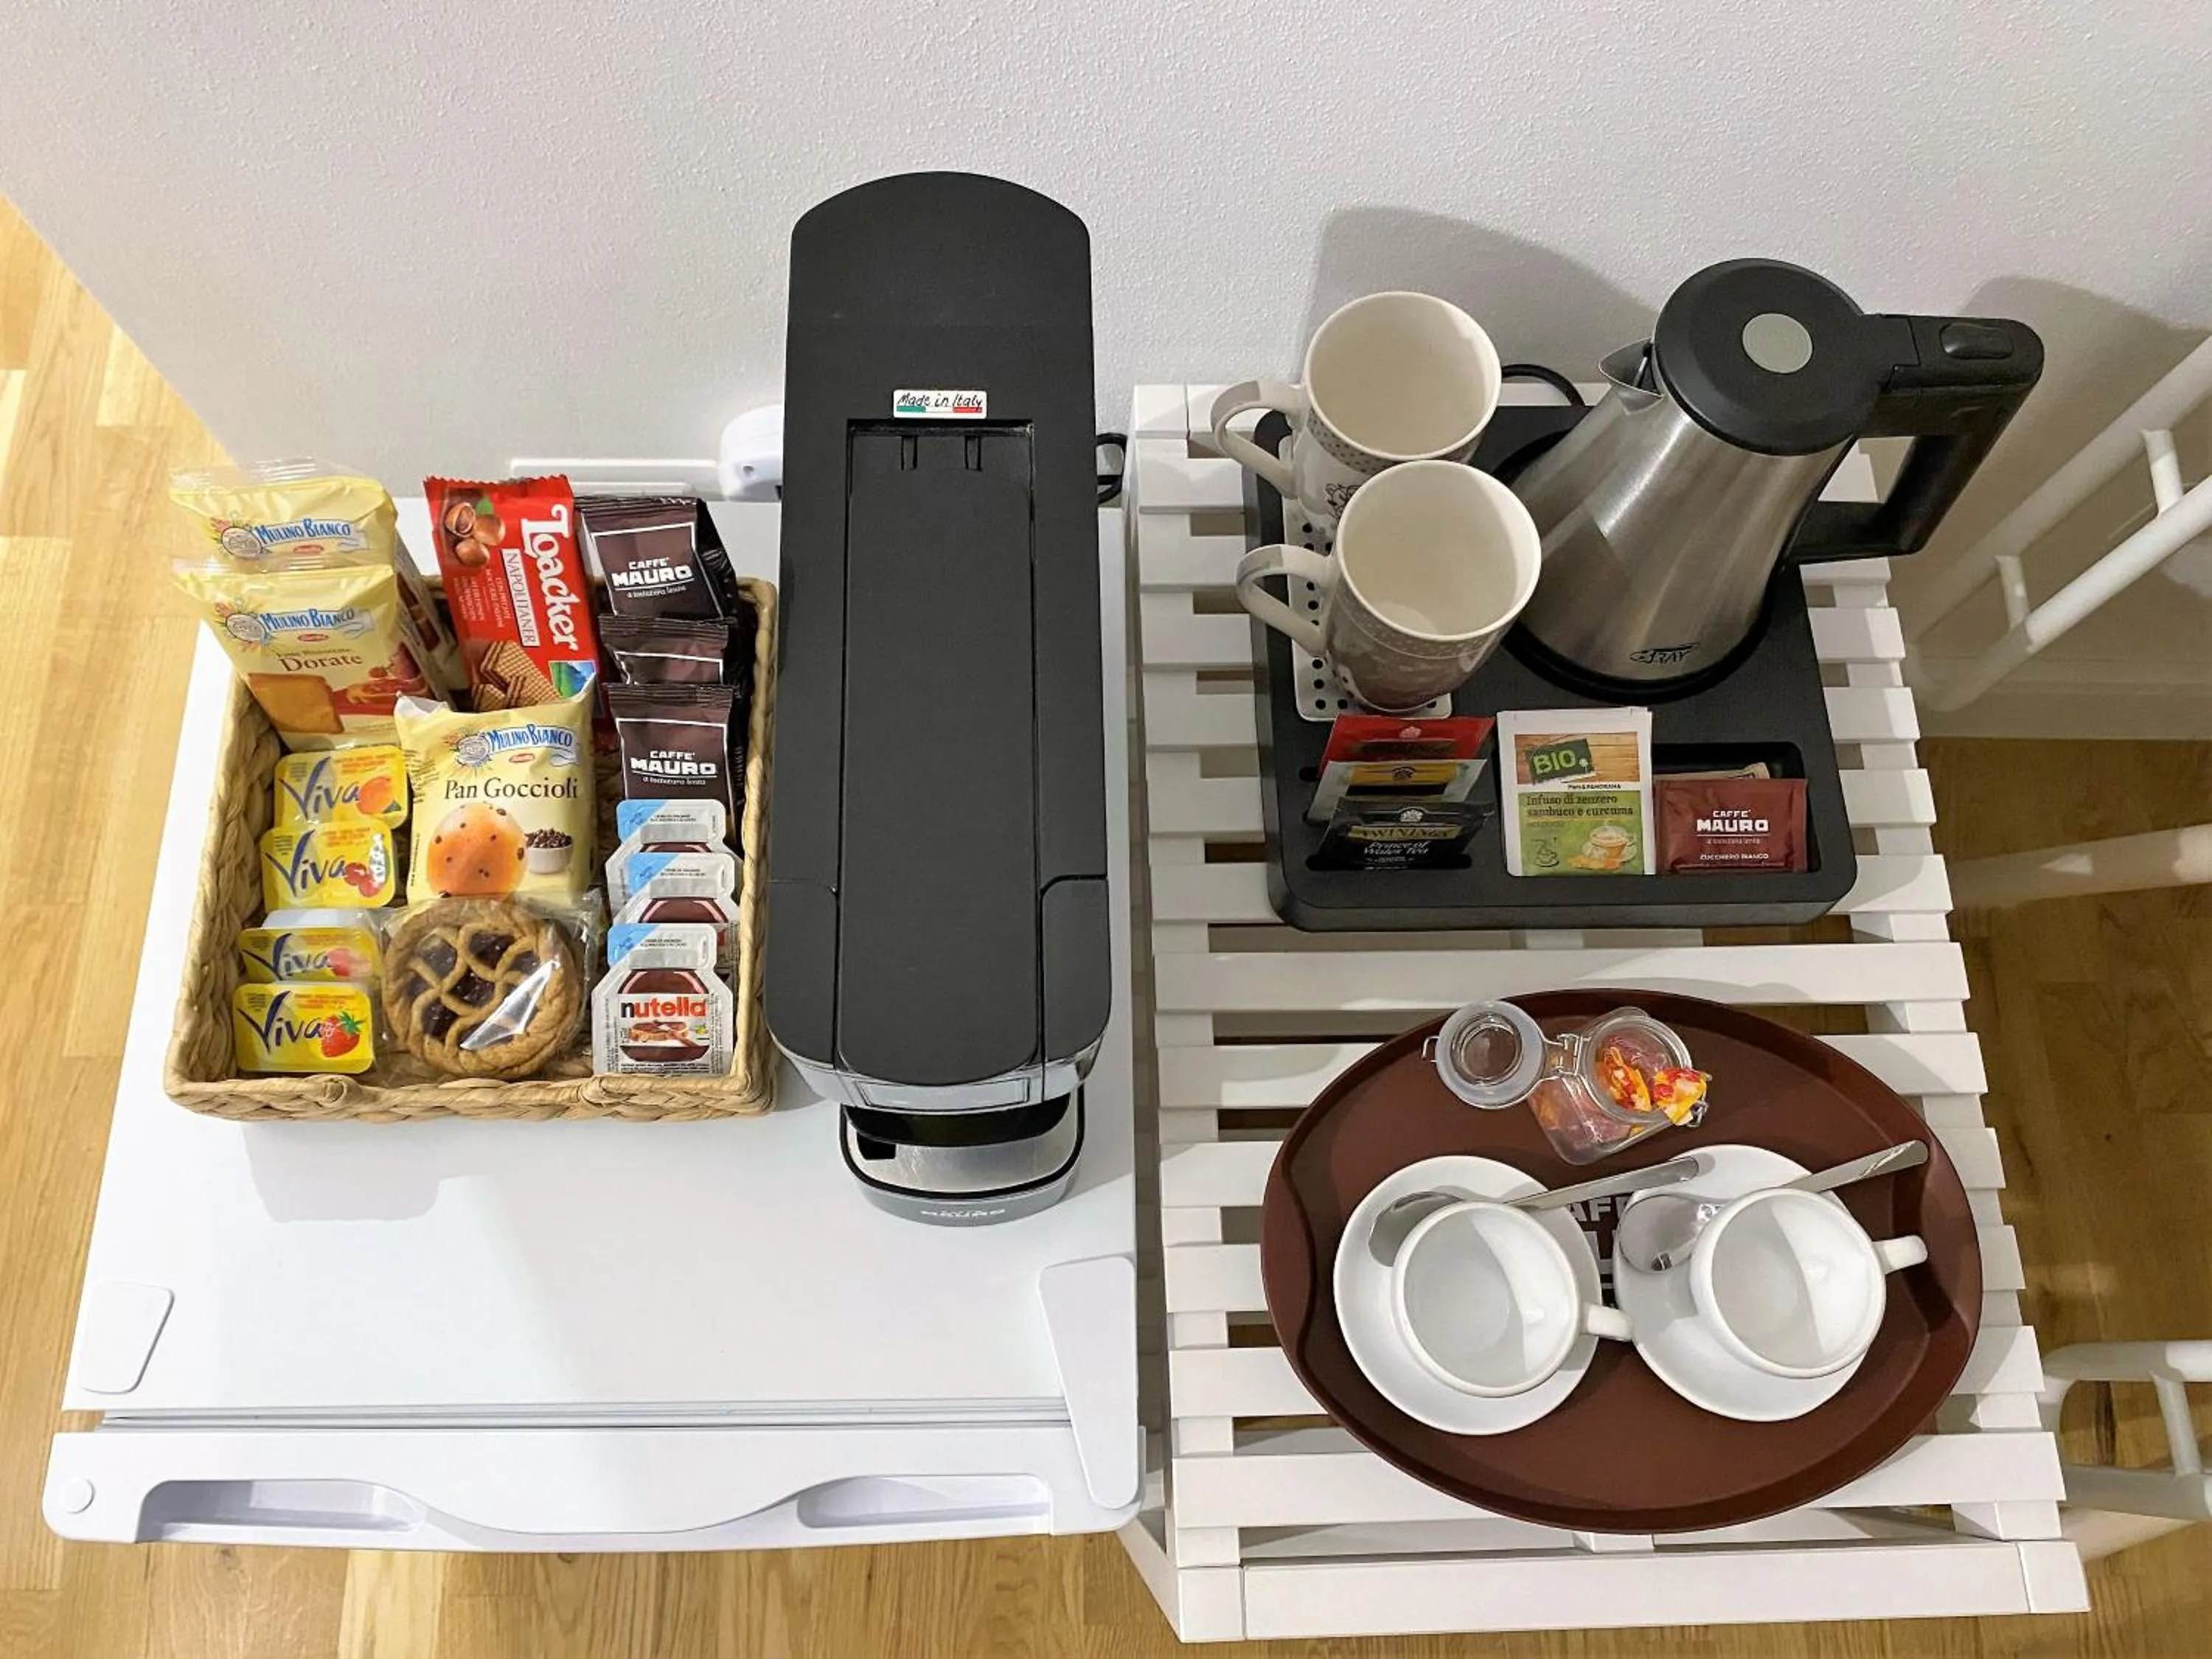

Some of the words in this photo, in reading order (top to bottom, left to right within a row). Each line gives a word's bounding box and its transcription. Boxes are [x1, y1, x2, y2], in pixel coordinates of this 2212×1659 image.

[897, 392, 931, 406] Made
[934, 392, 949, 407] in
[953, 393, 982, 411] Italy
[256, 524, 305, 545] MULINO
[303, 518, 350, 538] BIANCO
[521, 504, 581, 651] Loacker
[611, 565, 692, 586] MAURO
[505, 552, 538, 644] NAPOLITANER
[260, 613, 310, 631] MULINO
[308, 608, 355, 627] BIANCO
[279, 654, 363, 672] Dorate
[487, 729, 529, 751] MULINO
[526, 724, 572, 746] BIANCO
[630, 757, 717, 775] MAURO
[277, 756, 360, 821] Viva
[444, 779, 478, 800] Pan
[483, 776, 578, 799] Goccioli
[1526, 794, 1562, 805] Infuso
[1564, 793, 1573, 804] di
[1576, 795, 1618, 804] zenzero
[1527, 806, 1575, 816] sambuco
[1586, 807, 1634, 816] curcuma
[1697, 819, 1769, 832] MAURO
[265, 829, 347, 897] Viva
[241, 932, 332, 981] Viva
[621, 996, 706, 1018] nutella
[237, 990, 322, 1054] Viva
